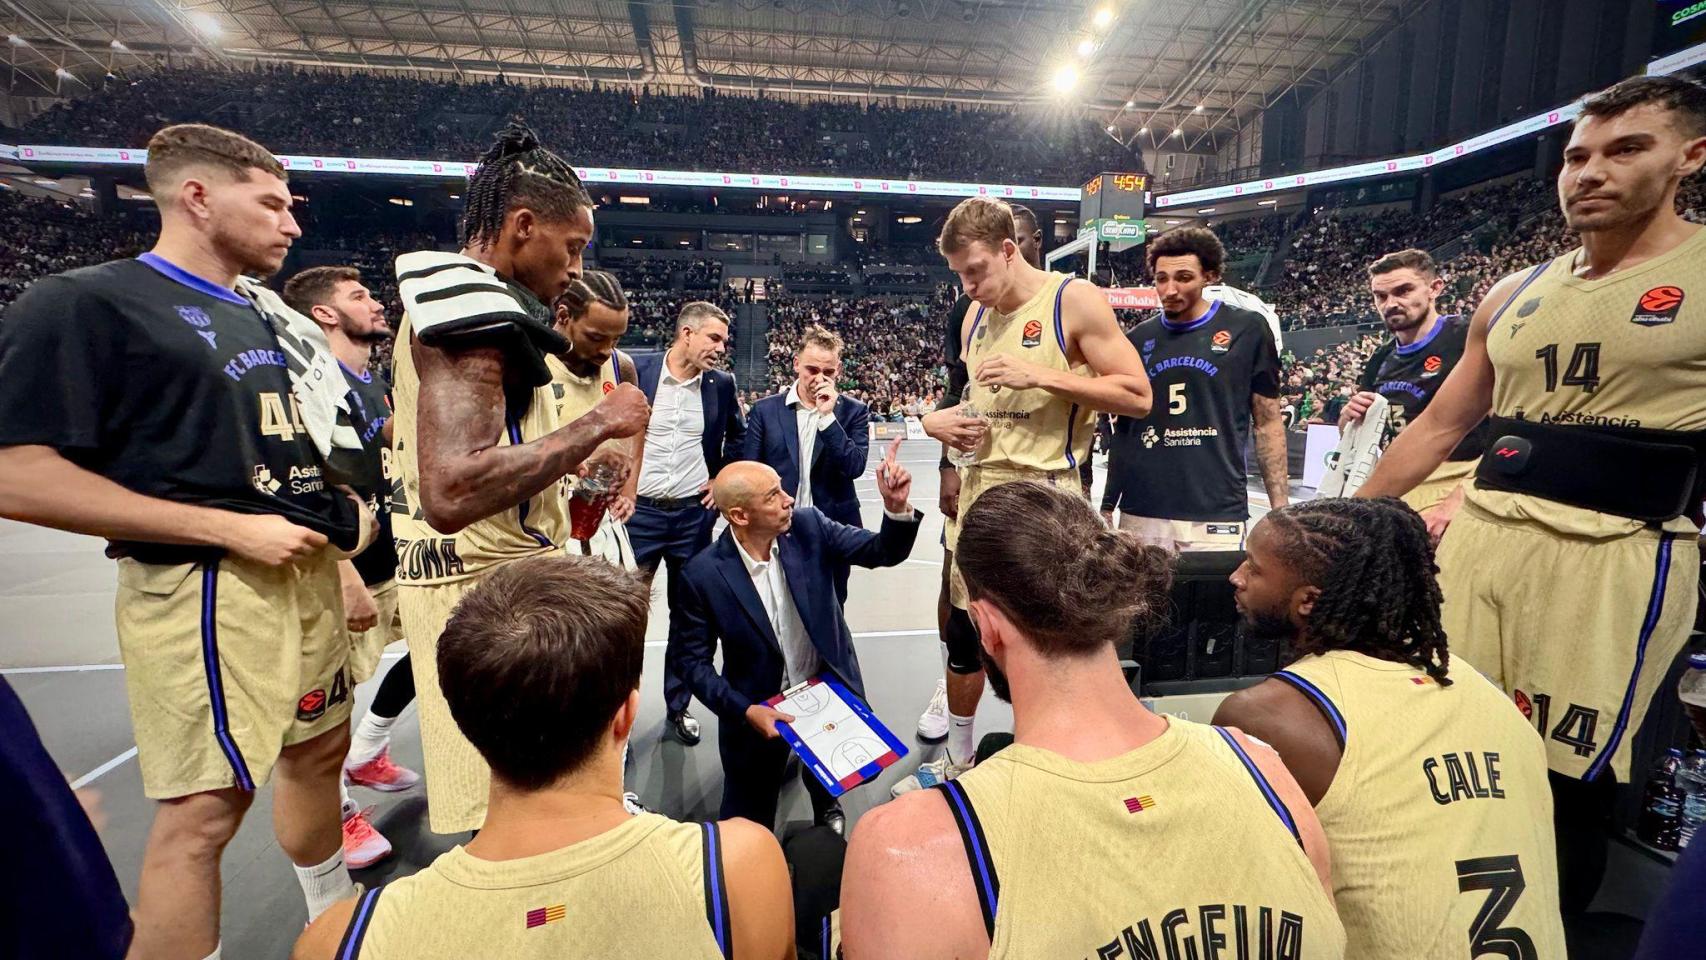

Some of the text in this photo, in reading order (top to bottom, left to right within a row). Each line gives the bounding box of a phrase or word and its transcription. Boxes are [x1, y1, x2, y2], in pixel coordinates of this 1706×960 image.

[1113, 174, 1147, 191] 4:54
[223, 358, 247, 382] FC
[1155, 356, 1219, 378] BARCELONA
[1535, 342, 1602, 394] 14
[1168, 382, 1188, 415] 5
[1164, 426, 1218, 437] Assistència
[1164, 437, 1202, 447] Sanitària
[1531, 692, 1600, 758] 14
[1422, 751, 1506, 806] CALE
[1454, 853, 1539, 960] 3
